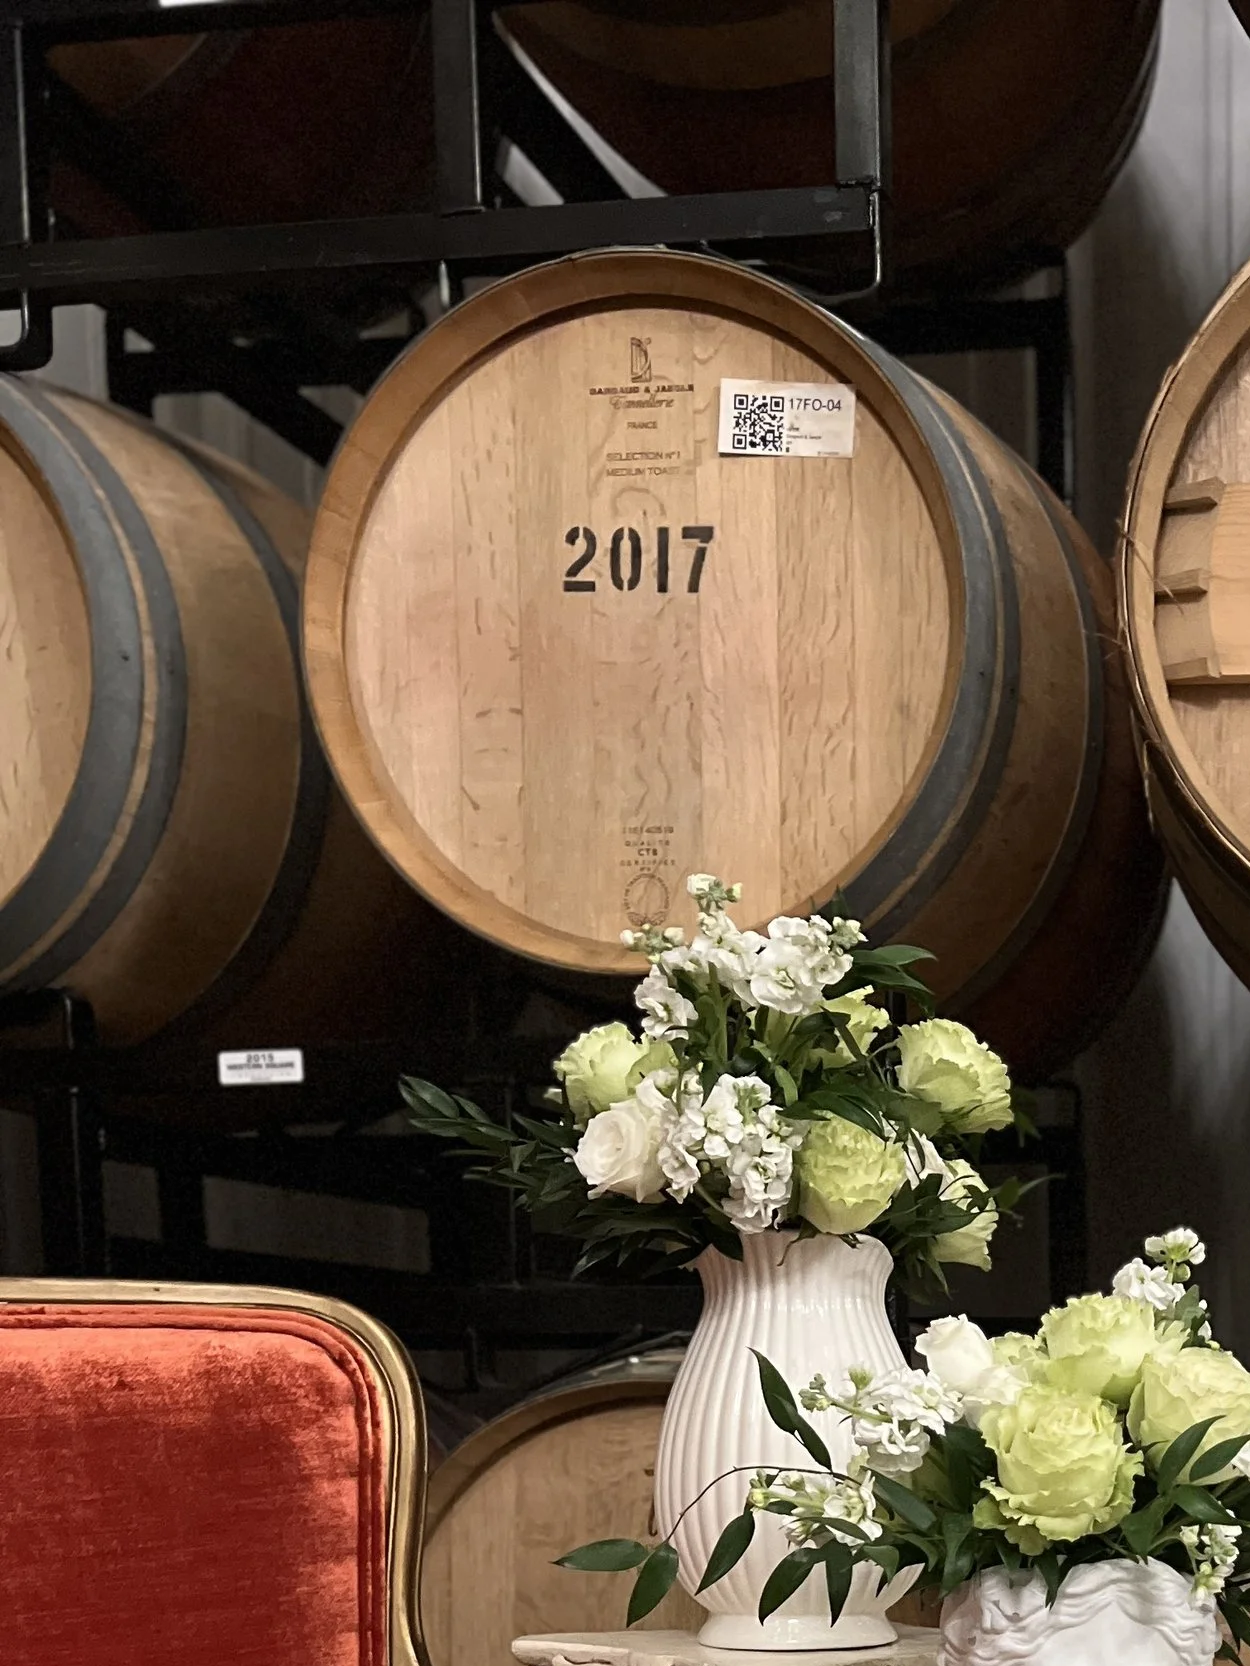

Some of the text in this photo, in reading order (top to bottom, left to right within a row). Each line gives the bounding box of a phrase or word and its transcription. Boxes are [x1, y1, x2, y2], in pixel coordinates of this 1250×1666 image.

[789, 398, 842, 411] 17FO-04
[627, 420, 658, 429] FRANCE
[606, 467, 646, 476] MEDIUM
[563, 526, 714, 593] 2017
